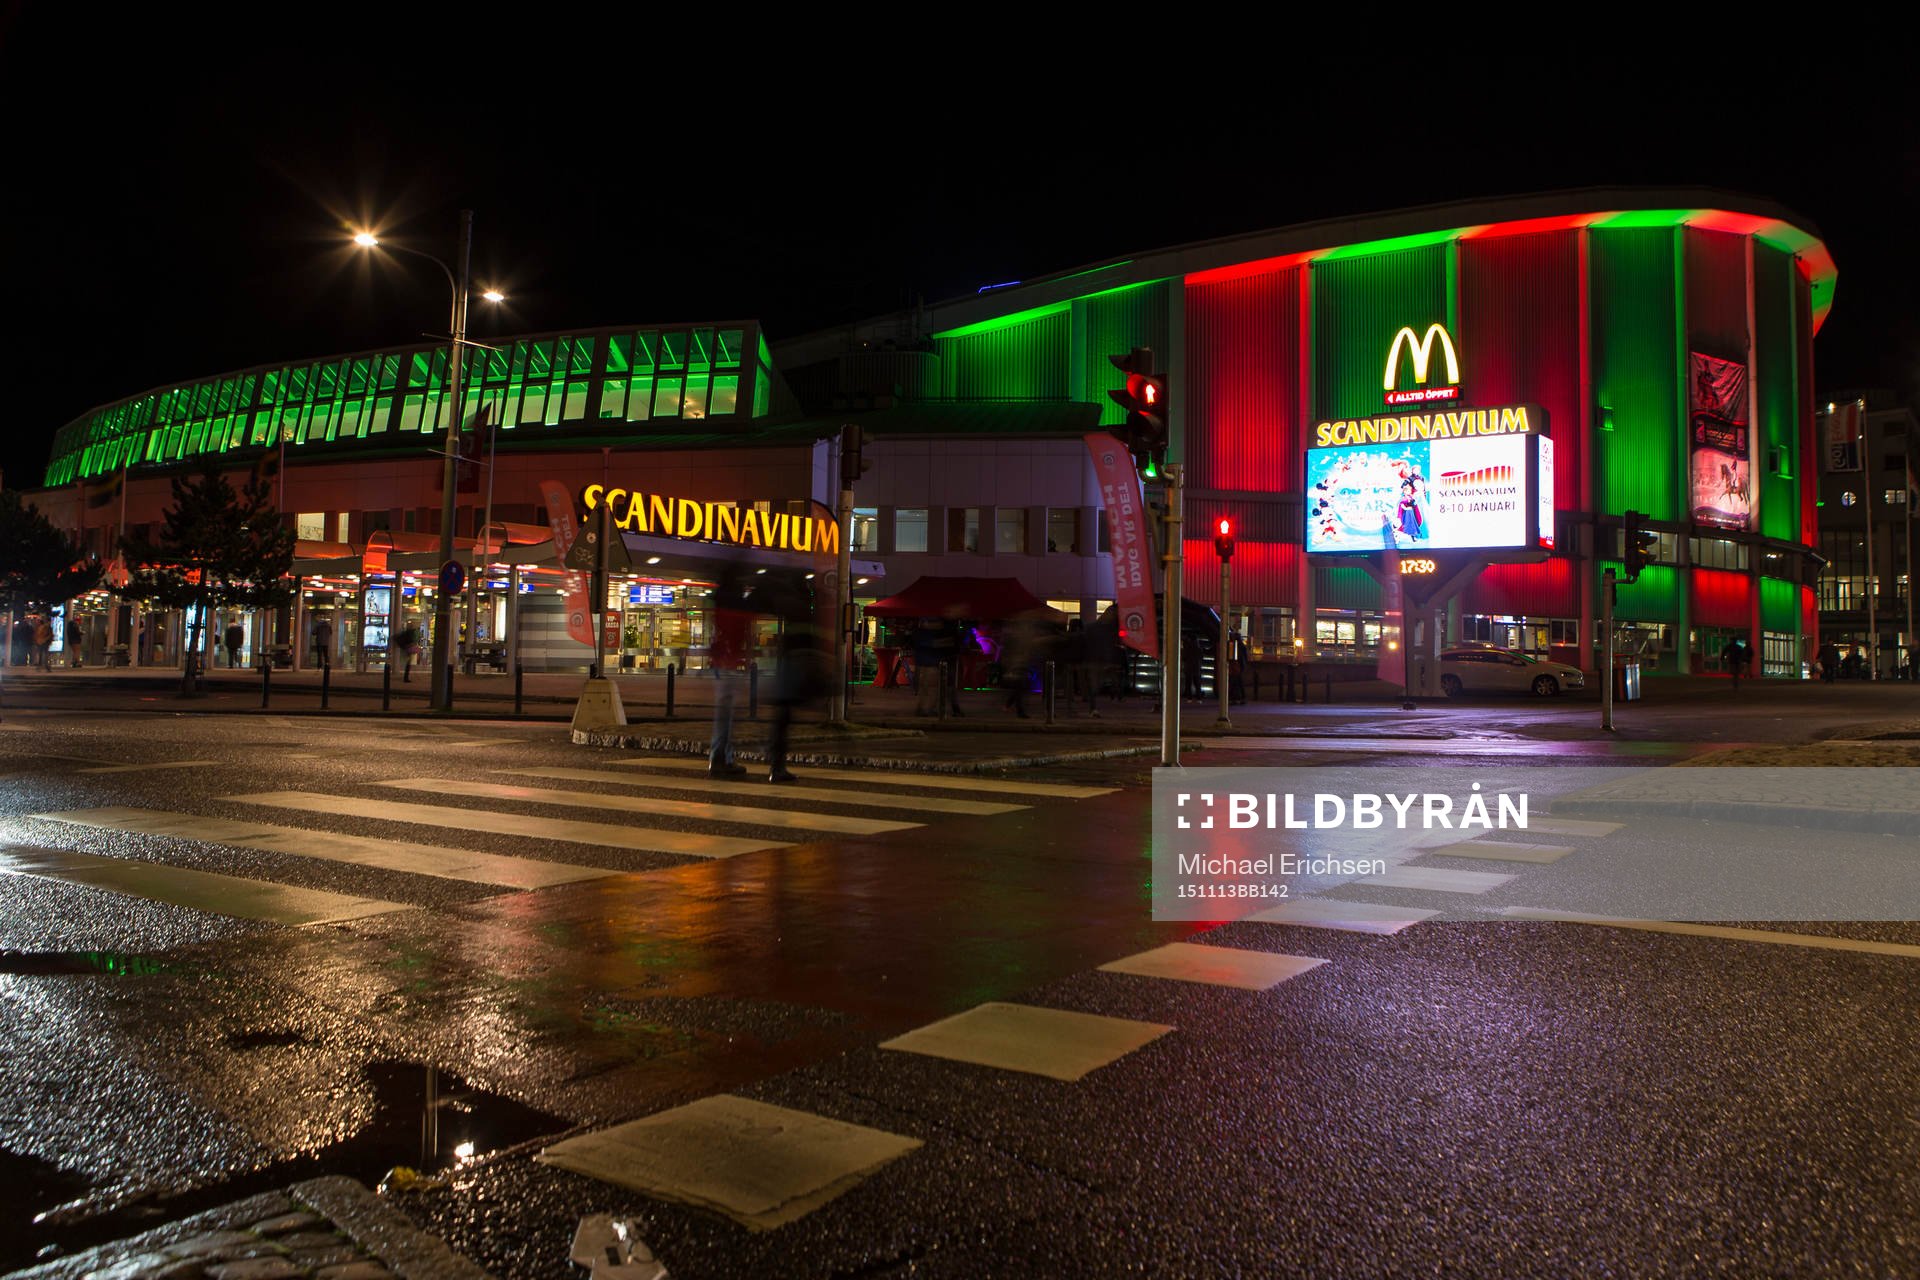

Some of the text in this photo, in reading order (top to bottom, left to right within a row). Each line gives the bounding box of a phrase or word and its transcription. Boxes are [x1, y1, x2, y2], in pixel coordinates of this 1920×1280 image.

[1395, 389, 1454, 402] ALLTID ÖPPET
[1317, 407, 1530, 446] SCANDINAVIUM
[1438, 487, 1516, 498] SCANDINAVIUM
[1439, 501, 1516, 514] 8-10 JANUARI
[584, 484, 839, 554] SCANDINAVIUM
[1400, 559, 1436, 574] 17:30
